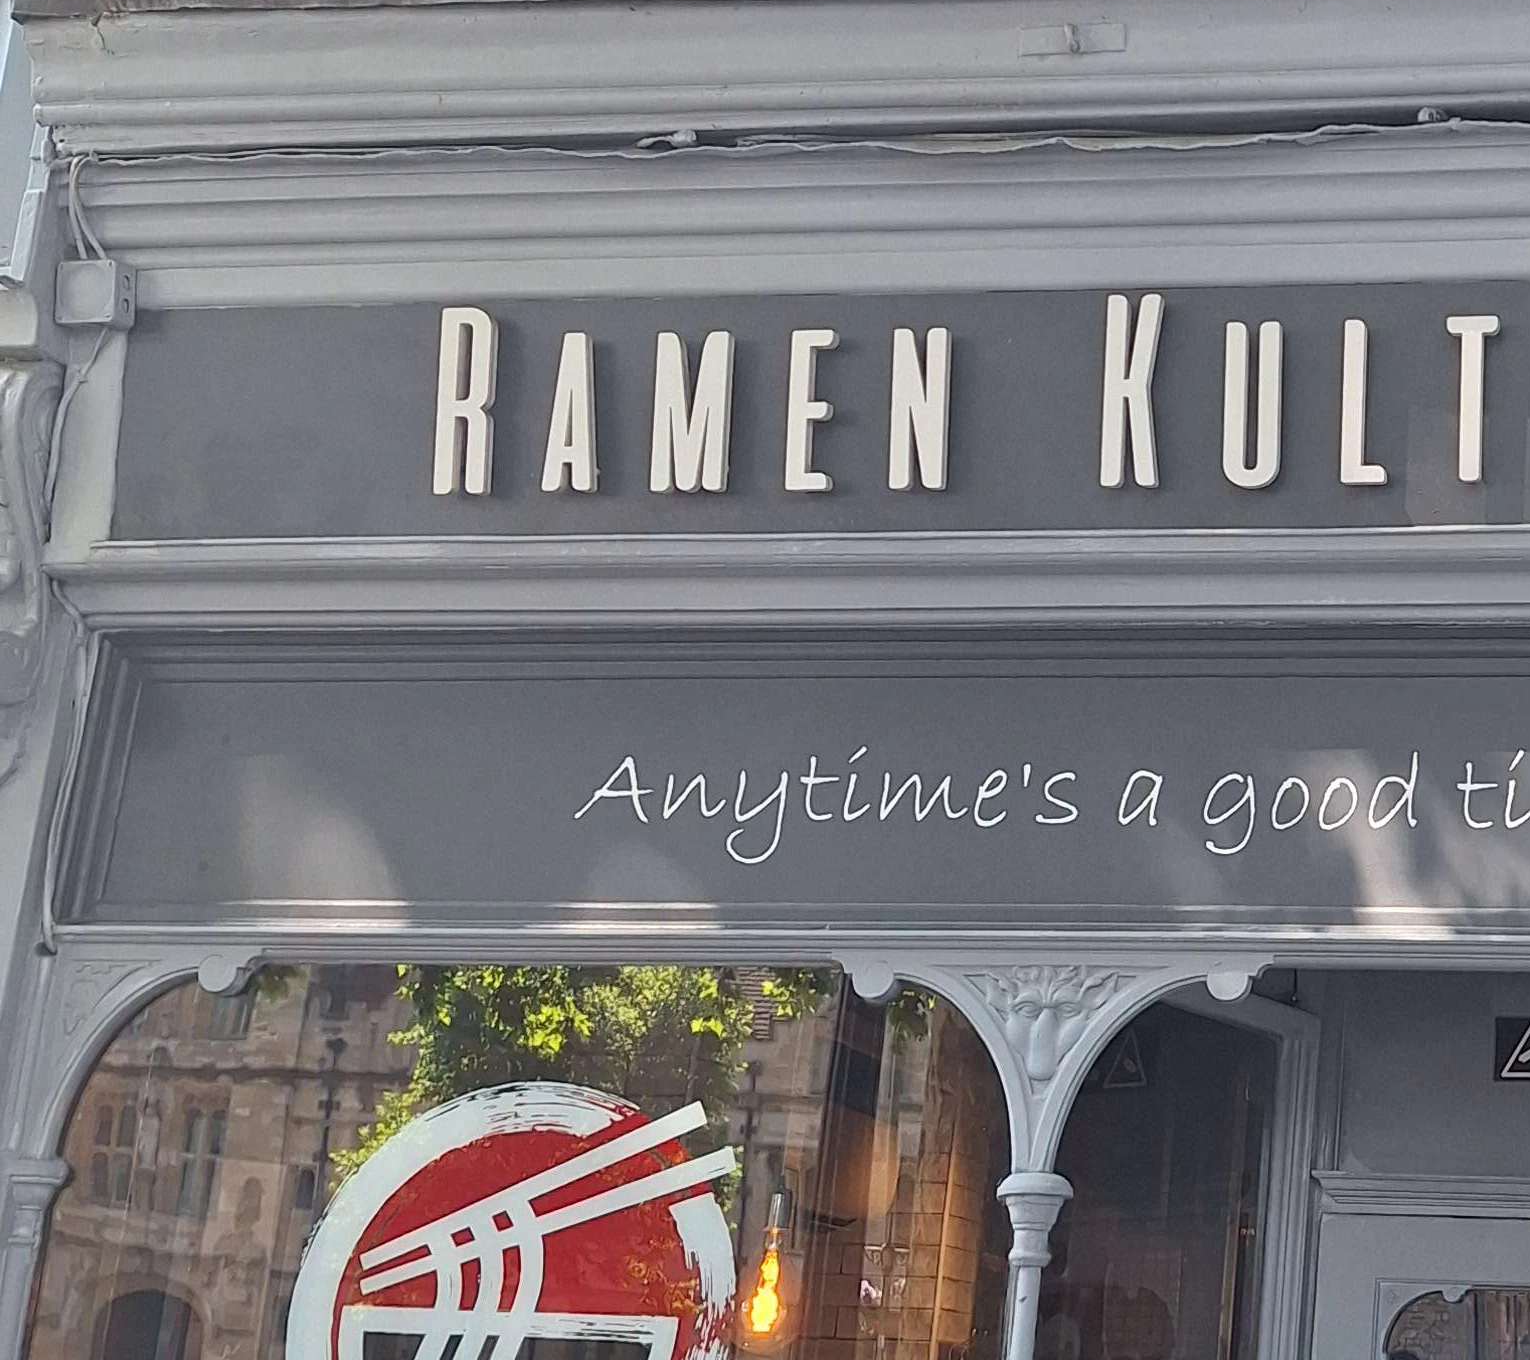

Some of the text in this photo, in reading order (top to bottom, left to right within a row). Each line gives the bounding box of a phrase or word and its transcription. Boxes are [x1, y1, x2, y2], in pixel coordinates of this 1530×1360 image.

[432, 306, 952, 496] RAMEN
[574, 745, 1079, 865] Anytime's
[1117, 769, 1164, 827] a
[1203, 750, 1419, 856] good
